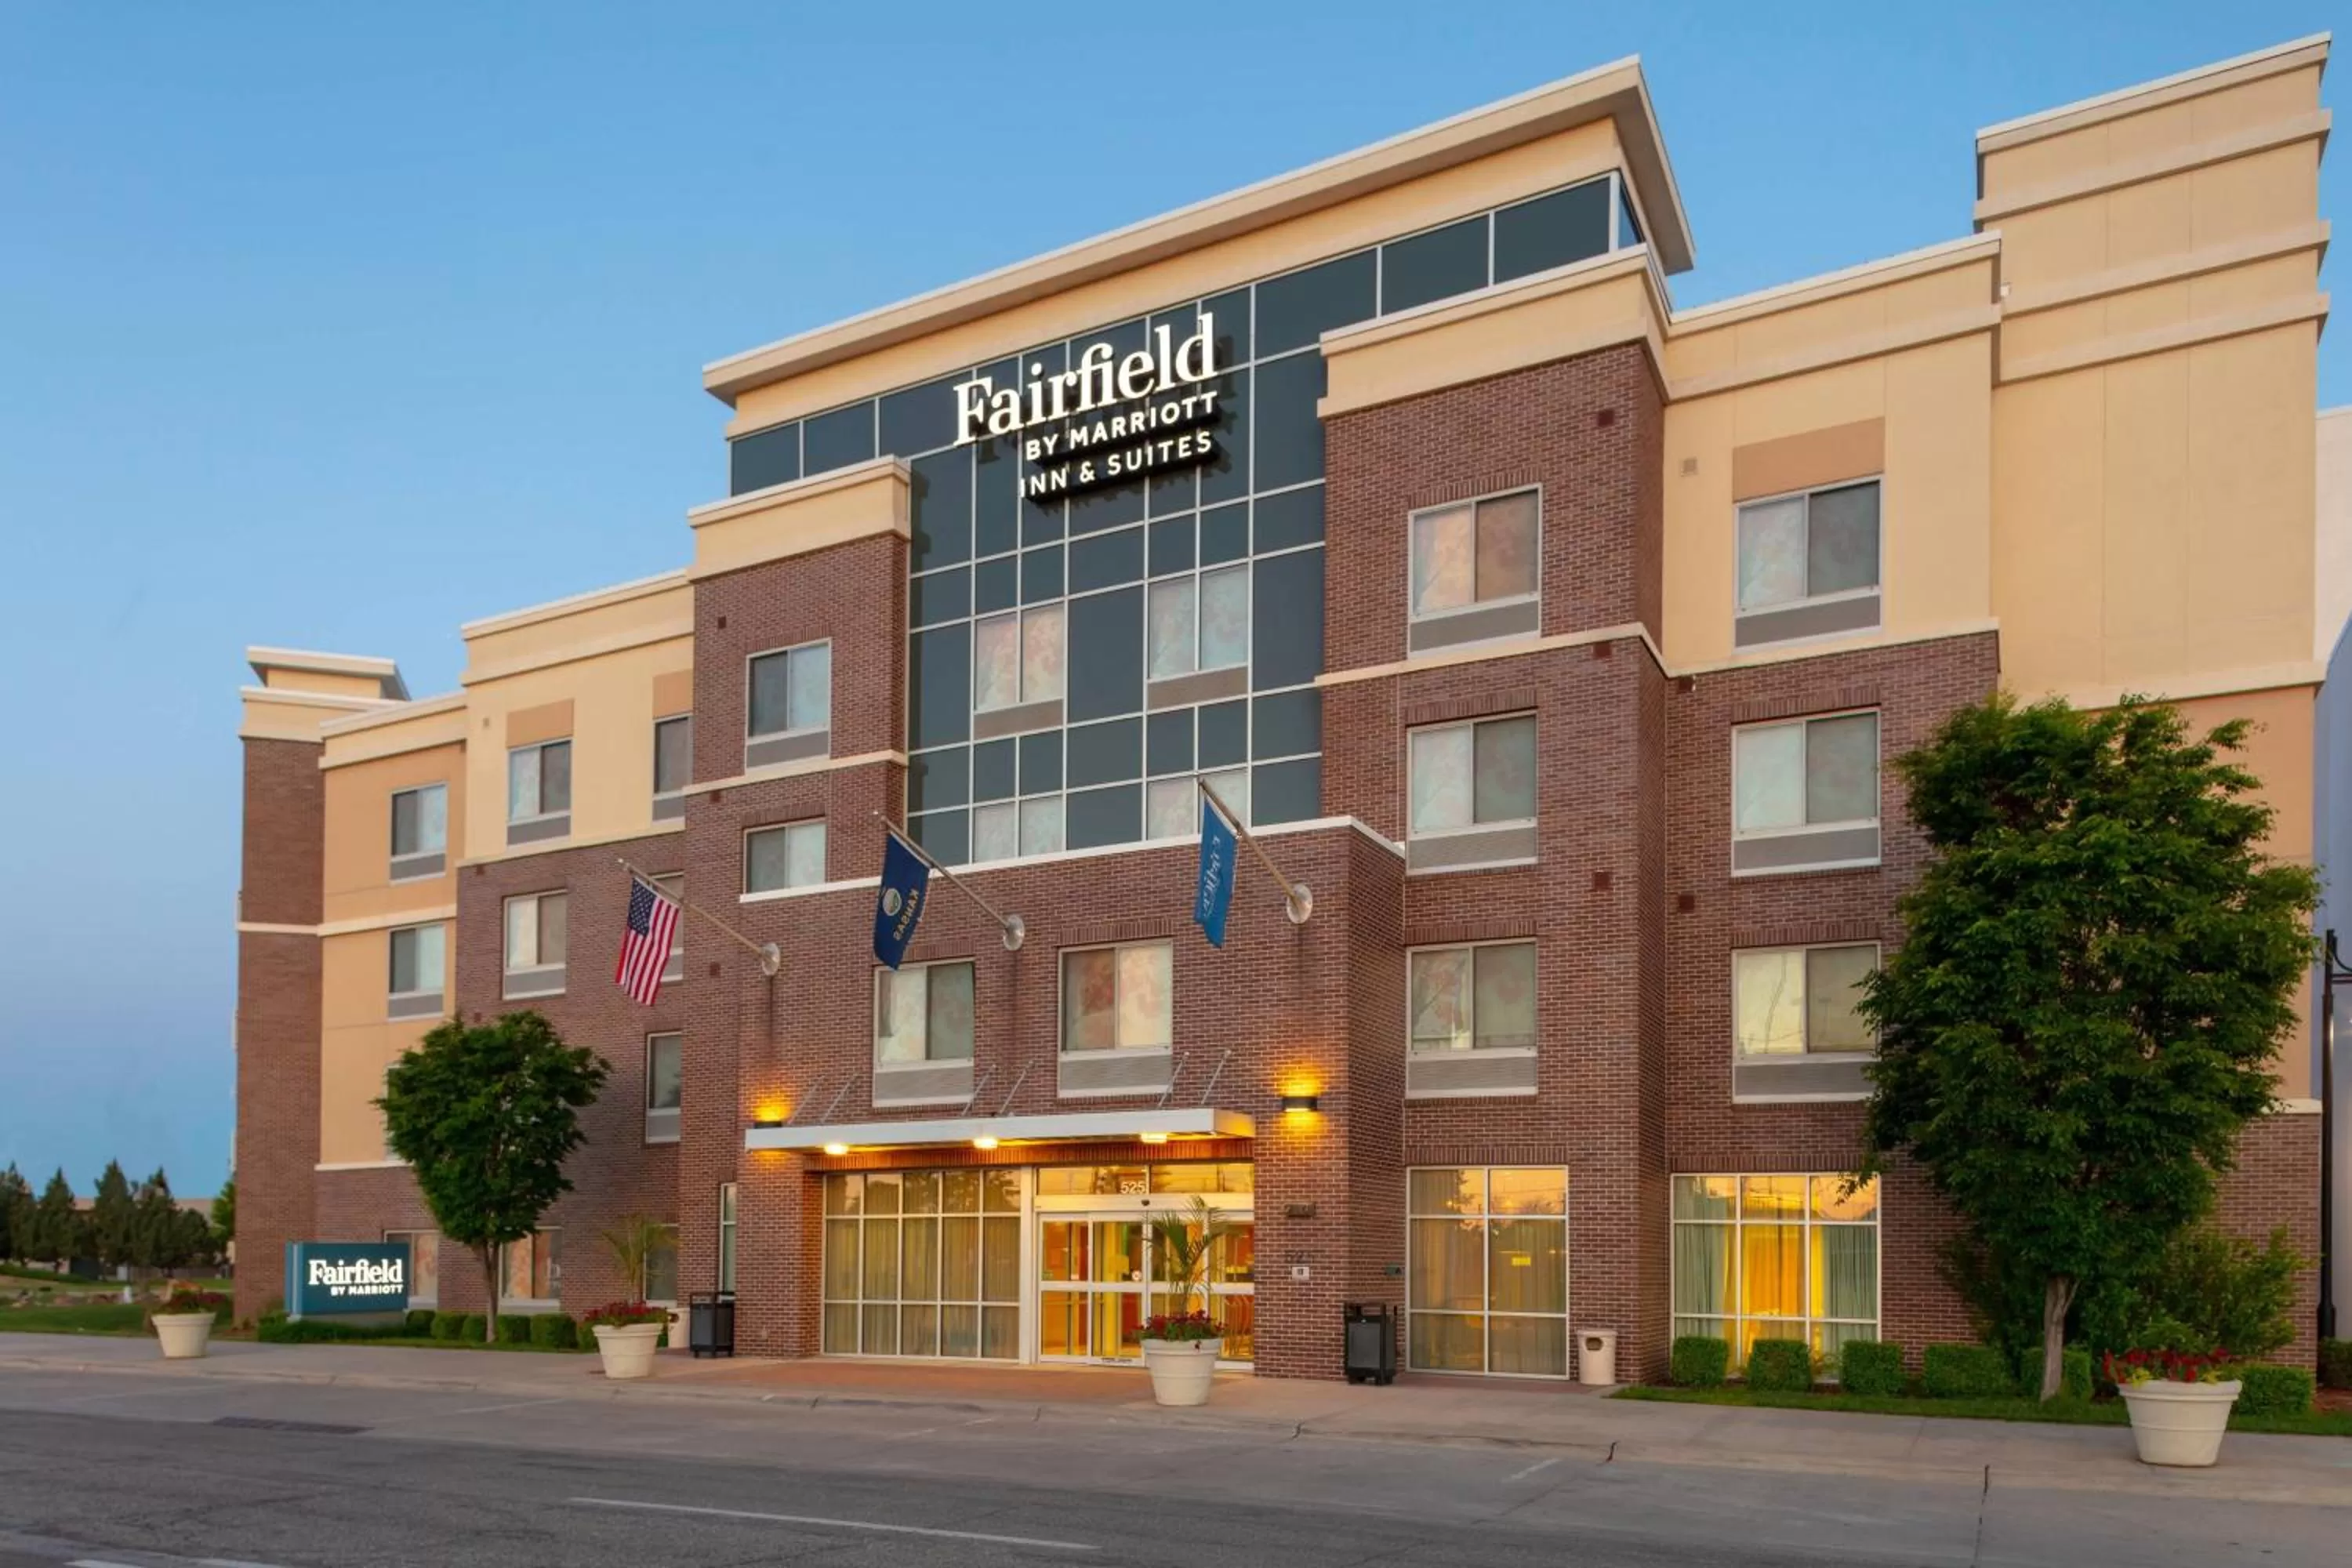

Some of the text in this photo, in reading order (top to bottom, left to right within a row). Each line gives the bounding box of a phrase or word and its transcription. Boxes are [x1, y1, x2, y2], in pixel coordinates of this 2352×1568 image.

[953, 312, 1218, 447] Fairfield
[1025, 390, 1218, 461] BY MARRIOTT
[1020, 430, 1213, 498] INN & SUITES
[1120, 1180, 1146, 1194] 525
[308, 1258, 404, 1285] Fairfield
[330, 1283, 405, 1297] BY MARRIOTT
